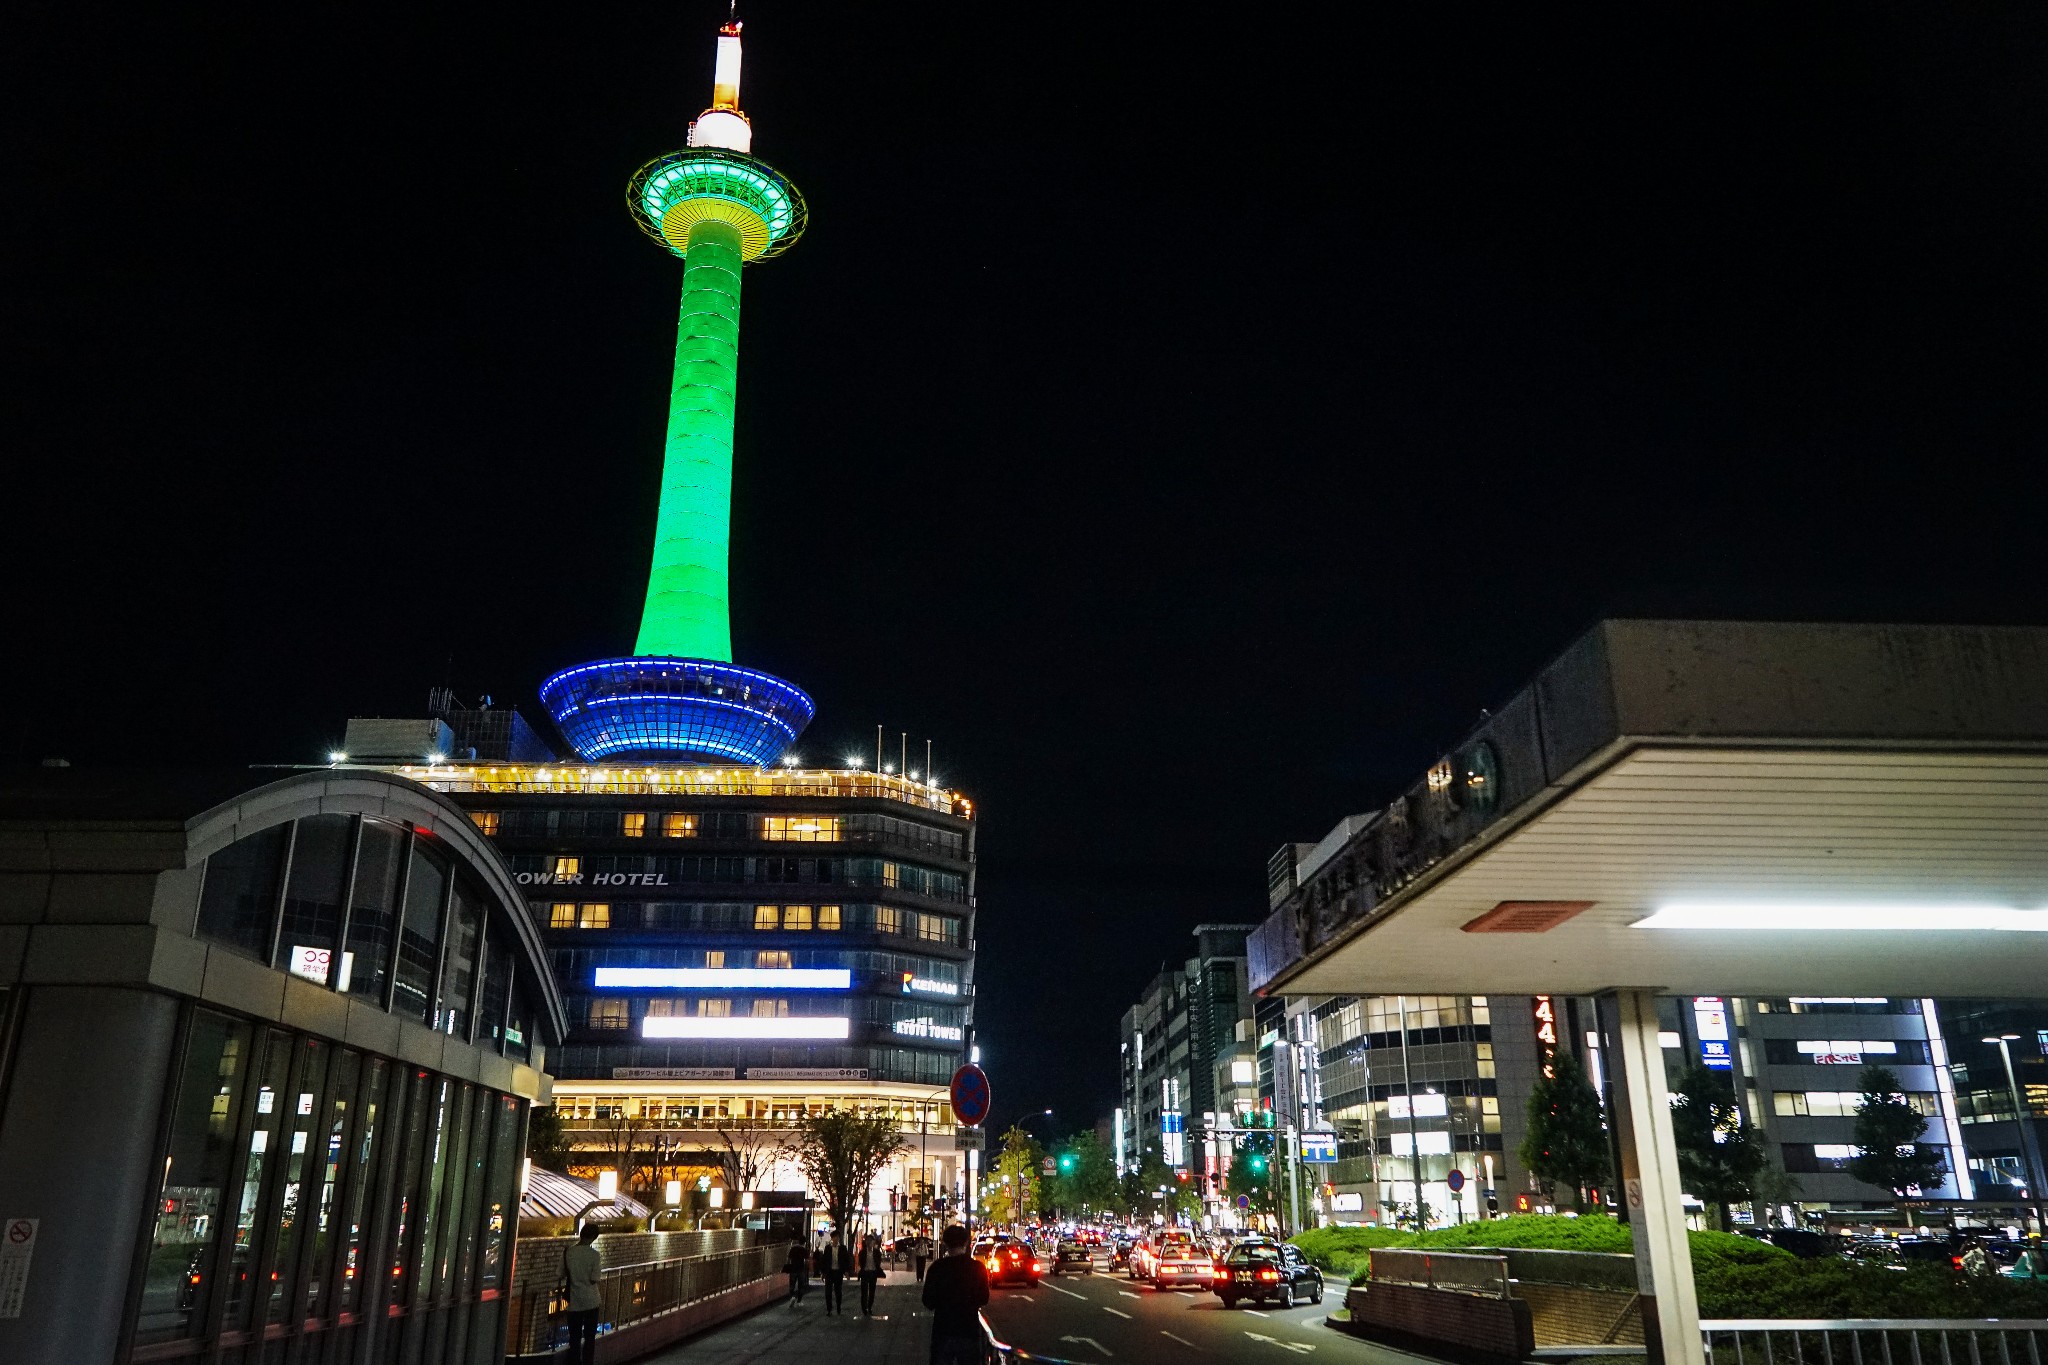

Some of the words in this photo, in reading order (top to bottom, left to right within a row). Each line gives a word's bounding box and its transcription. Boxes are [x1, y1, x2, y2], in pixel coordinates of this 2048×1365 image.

[512, 872, 584, 885] OWER
[592, 873, 669, 886] HOTEL
[911, 979, 958, 995] KEIHAN
[896, 1021, 928, 1037] KYOTO
[929, 1025, 961, 1041] TOWER
